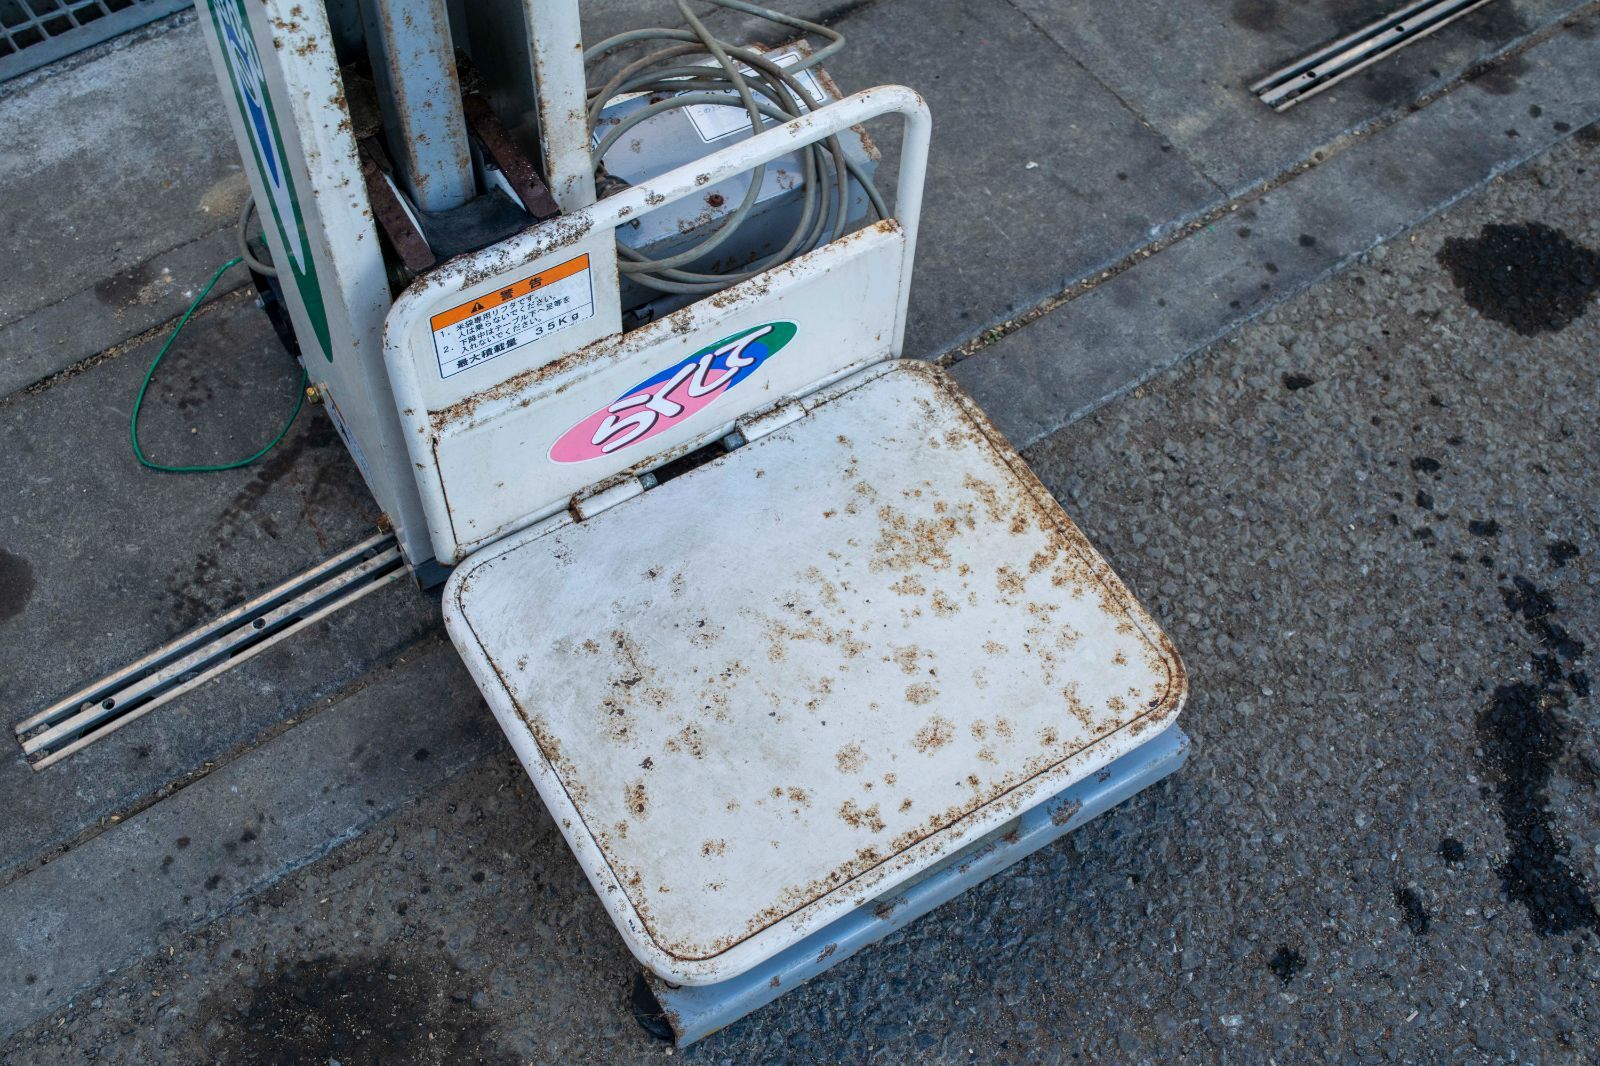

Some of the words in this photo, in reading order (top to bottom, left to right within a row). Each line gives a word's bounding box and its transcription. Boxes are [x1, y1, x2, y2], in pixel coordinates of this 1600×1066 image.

[499, 276, 543, 301] 警告
[458, 295, 556, 338] 人は乗らないでください。
[459, 295, 570, 346] 下降中はテーブル下へ足等を
[456, 337, 518, 369] 最大積載量
[461, 317, 542, 354] 入れないでください。
